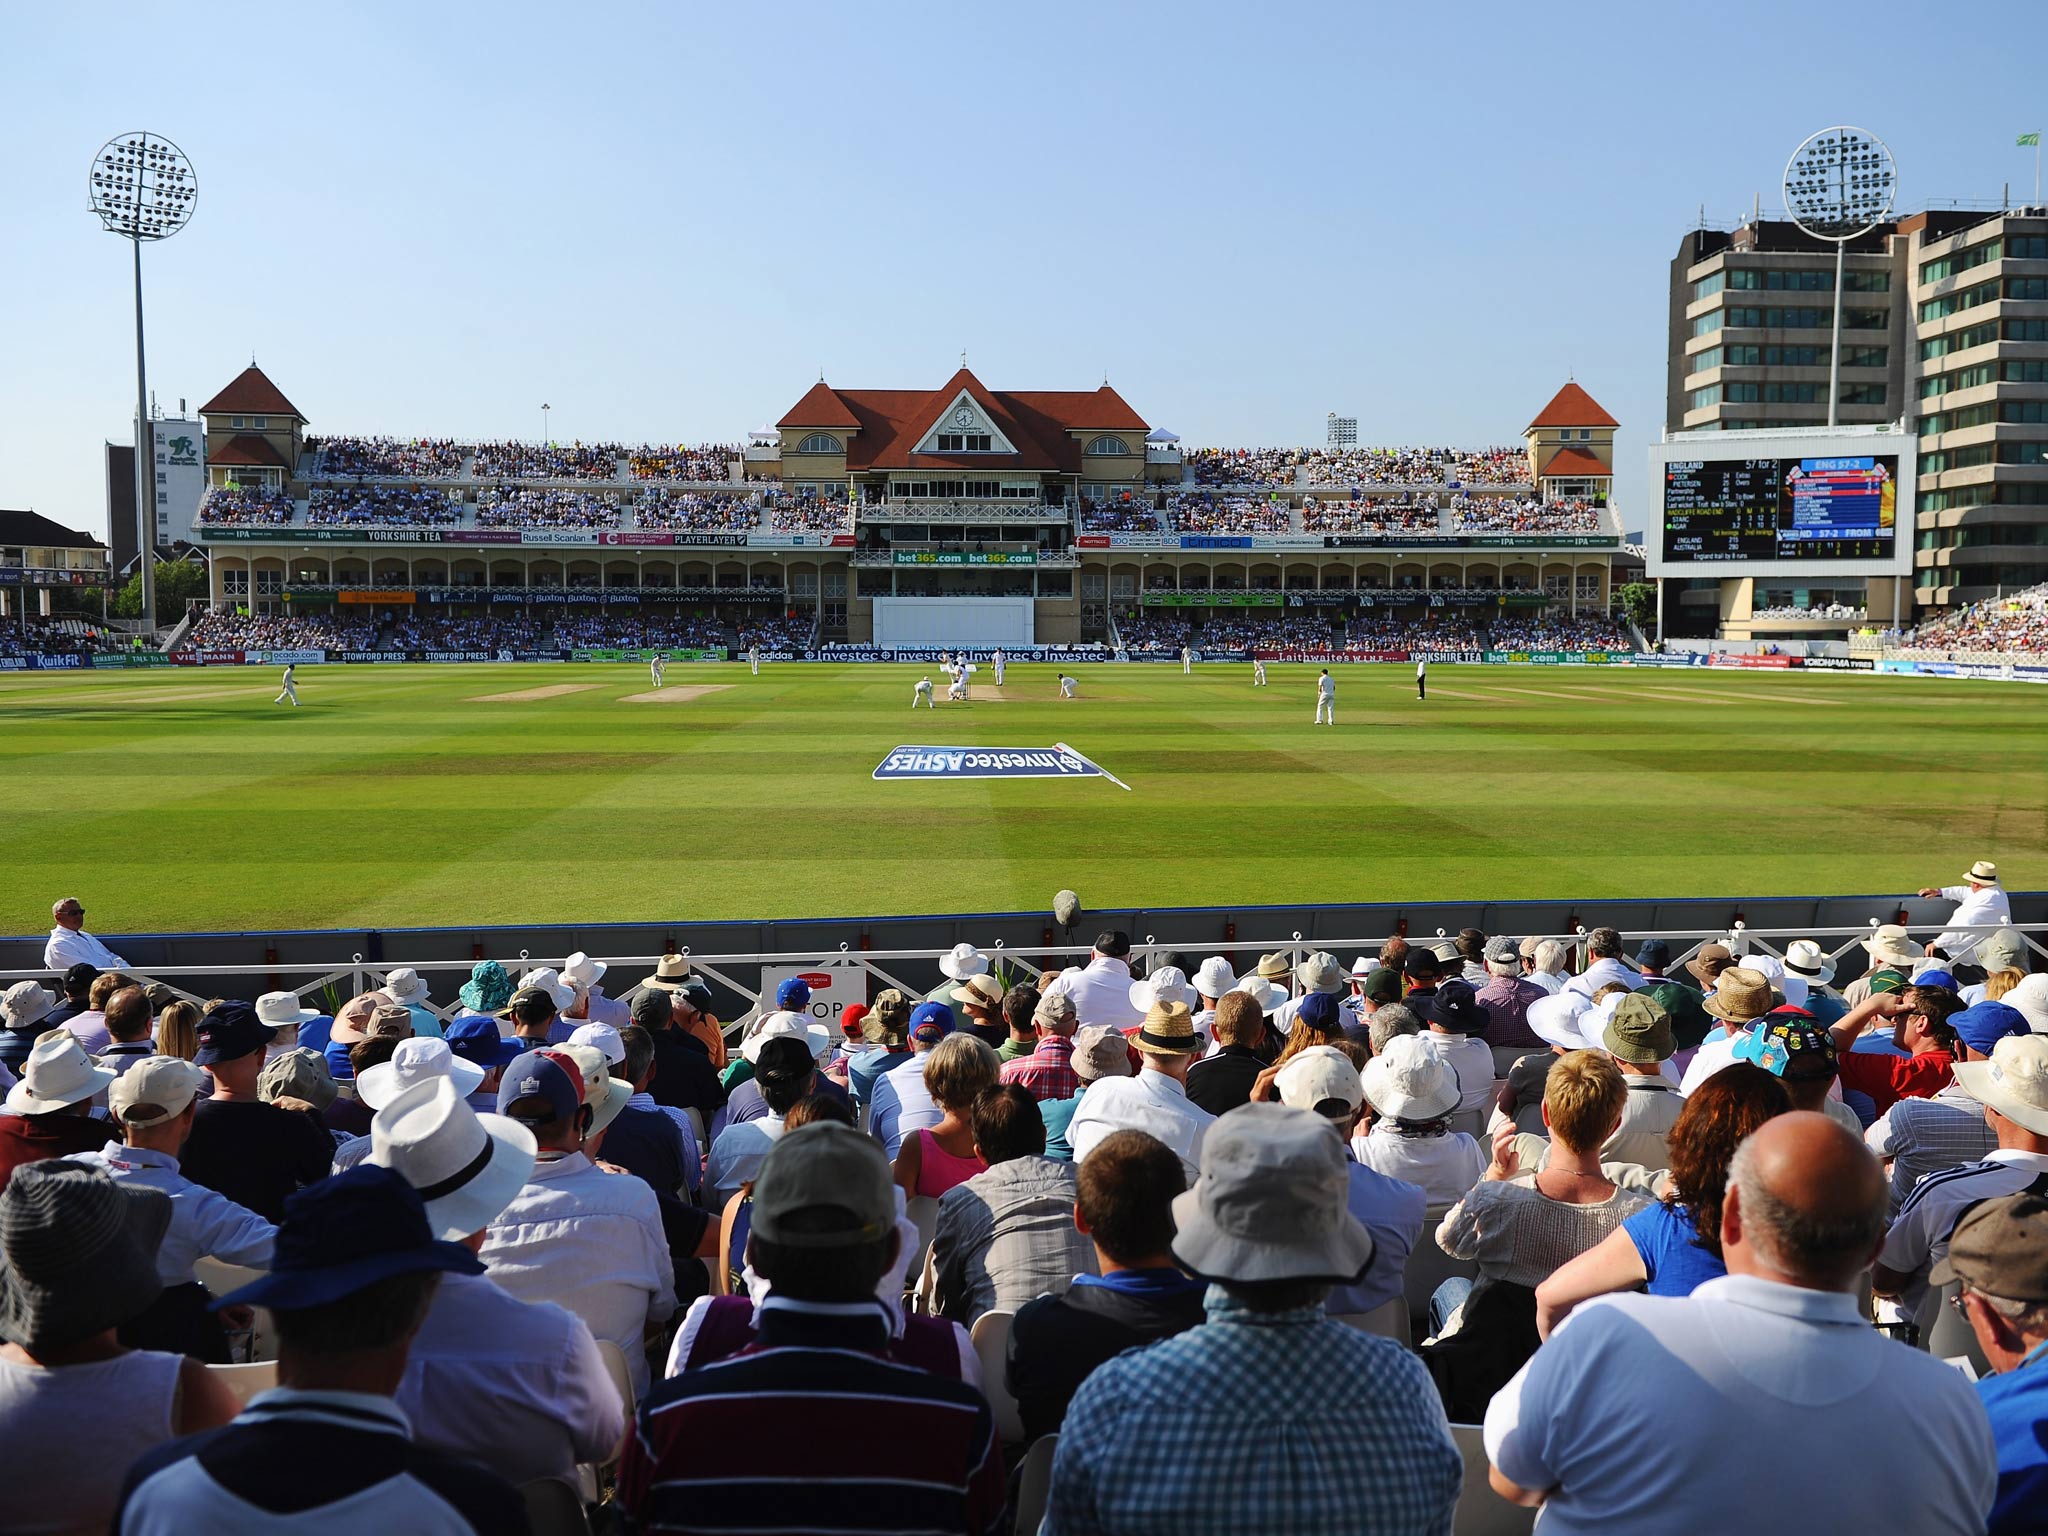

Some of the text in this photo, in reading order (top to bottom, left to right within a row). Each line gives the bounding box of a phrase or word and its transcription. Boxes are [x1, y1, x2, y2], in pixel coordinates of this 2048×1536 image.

[1746, 460, 1777, 469] 57 for 2
[368, 531, 441, 541] YORKSHIRE TEA
[523, 534, 552, 542] Russell
[554, 534, 586, 542] Scanlan
[675, 536, 736, 544] PLAYERLAYER
[1188, 537, 1241, 547] timico
[898, 553, 1032, 563] bet365.com bet365.com
[492, 593, 522, 603] Buxton
[536, 594, 565, 603] Buxton
[568, 594, 597, 603] Buxton
[610, 594, 639, 603] Buxton
[342, 652, 406, 661] STOWFORD PRESS
[425, 652, 488, 660] STOWFORD PRESS
[760, 651, 793, 660] adidas
[818, 651, 879, 661] Investec
[970, 651, 1029, 660] Invtec
[1045, 651, 1105, 661] Investec
[1279, 652, 1349, 662] Laithwaite's
[1464, 652, 1482, 662] TEA
[1489, 652, 1557, 662] bet365.com
[1566, 652, 1634, 662] bet365.com
[1657, 653, 1689, 661] Payments
[1, 658, 27, 668] ENGLAND
[1804, 657, 1849, 667] YOKOHAMA
[884, 752, 1067, 772] Investec ASHES
